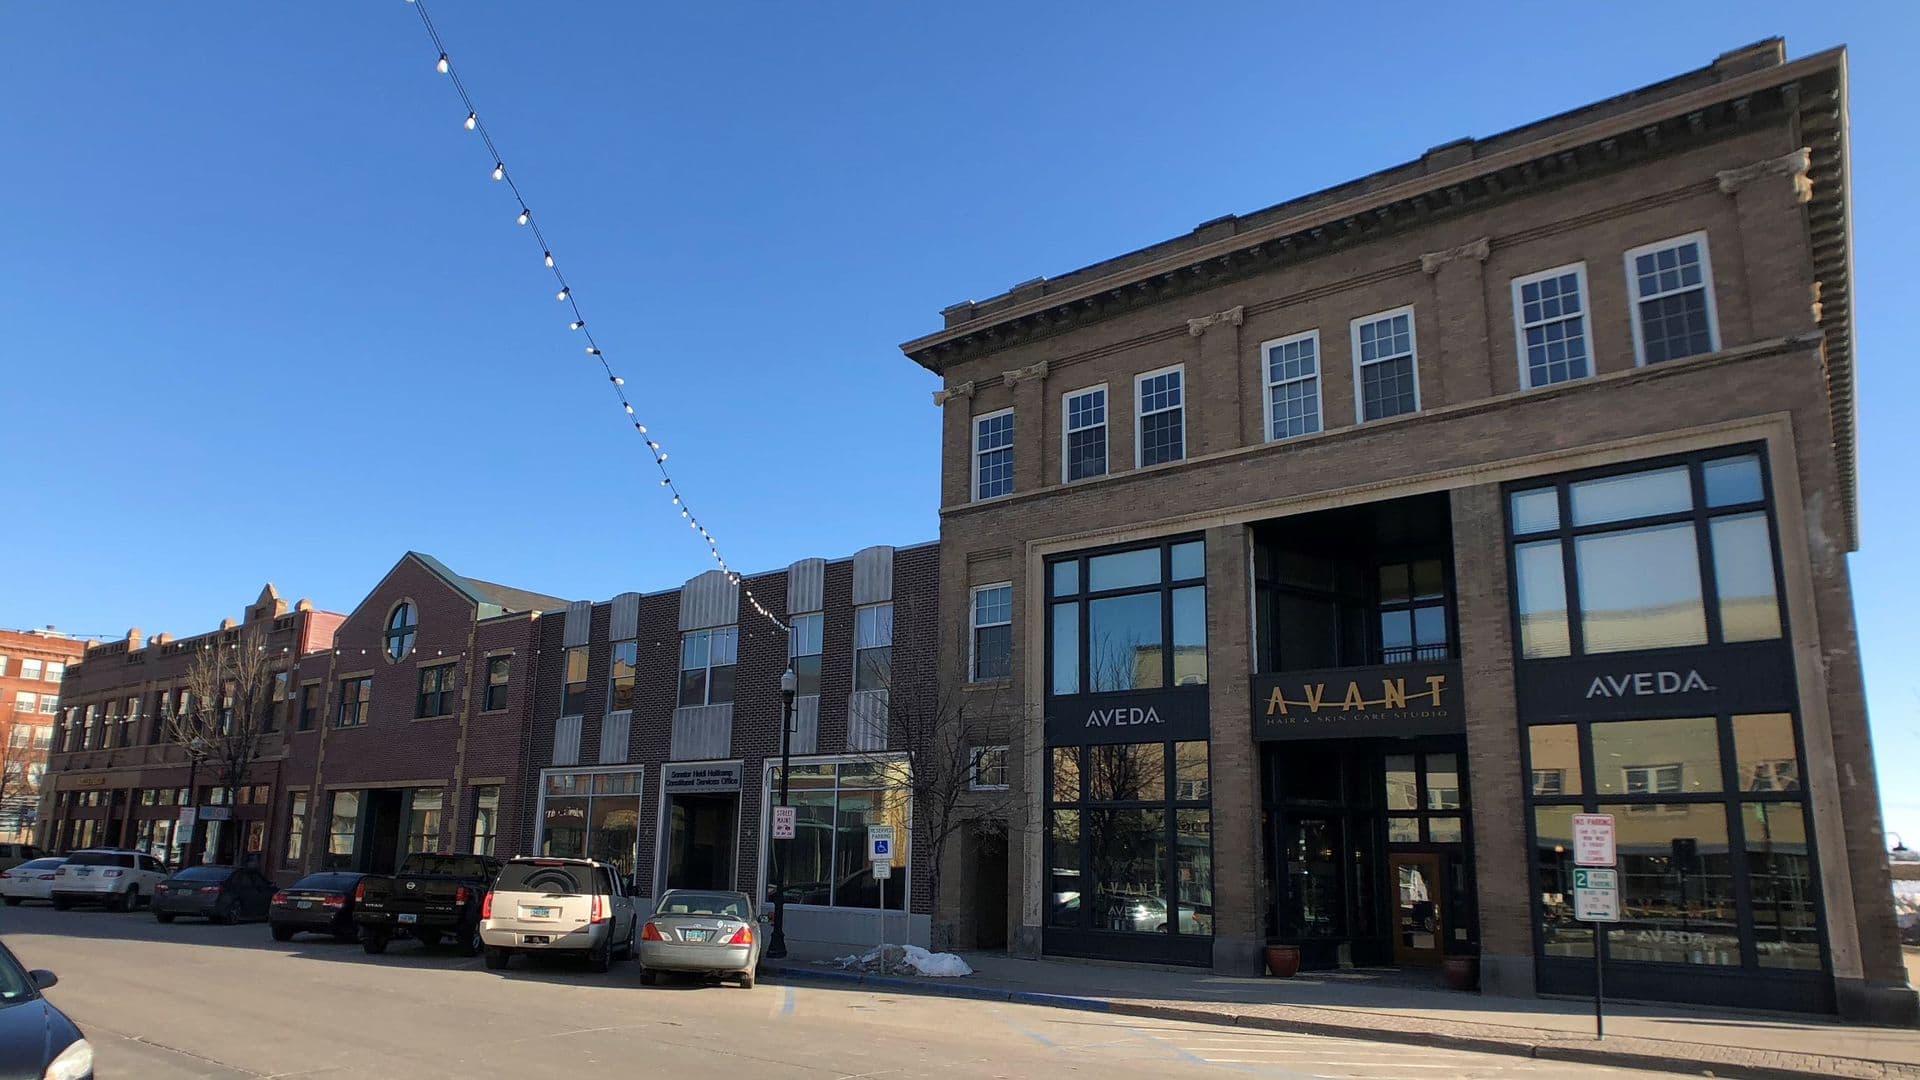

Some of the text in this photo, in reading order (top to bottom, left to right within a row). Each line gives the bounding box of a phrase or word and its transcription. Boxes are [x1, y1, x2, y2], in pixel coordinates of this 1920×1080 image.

[1586, 669, 1710, 699] AVEDA
[1266, 675, 1446, 715] AVANT
[1085, 706, 1162, 728] AVEDA
[1266, 716, 1296, 726] HAIR
[1317, 714, 1347, 723] SKIN
[1354, 711, 1389, 721] CARE
[1394, 709, 1449, 720] STUDIO
[1097, 881, 1162, 897] AVANT
[1576, 872, 1587, 887] 2
